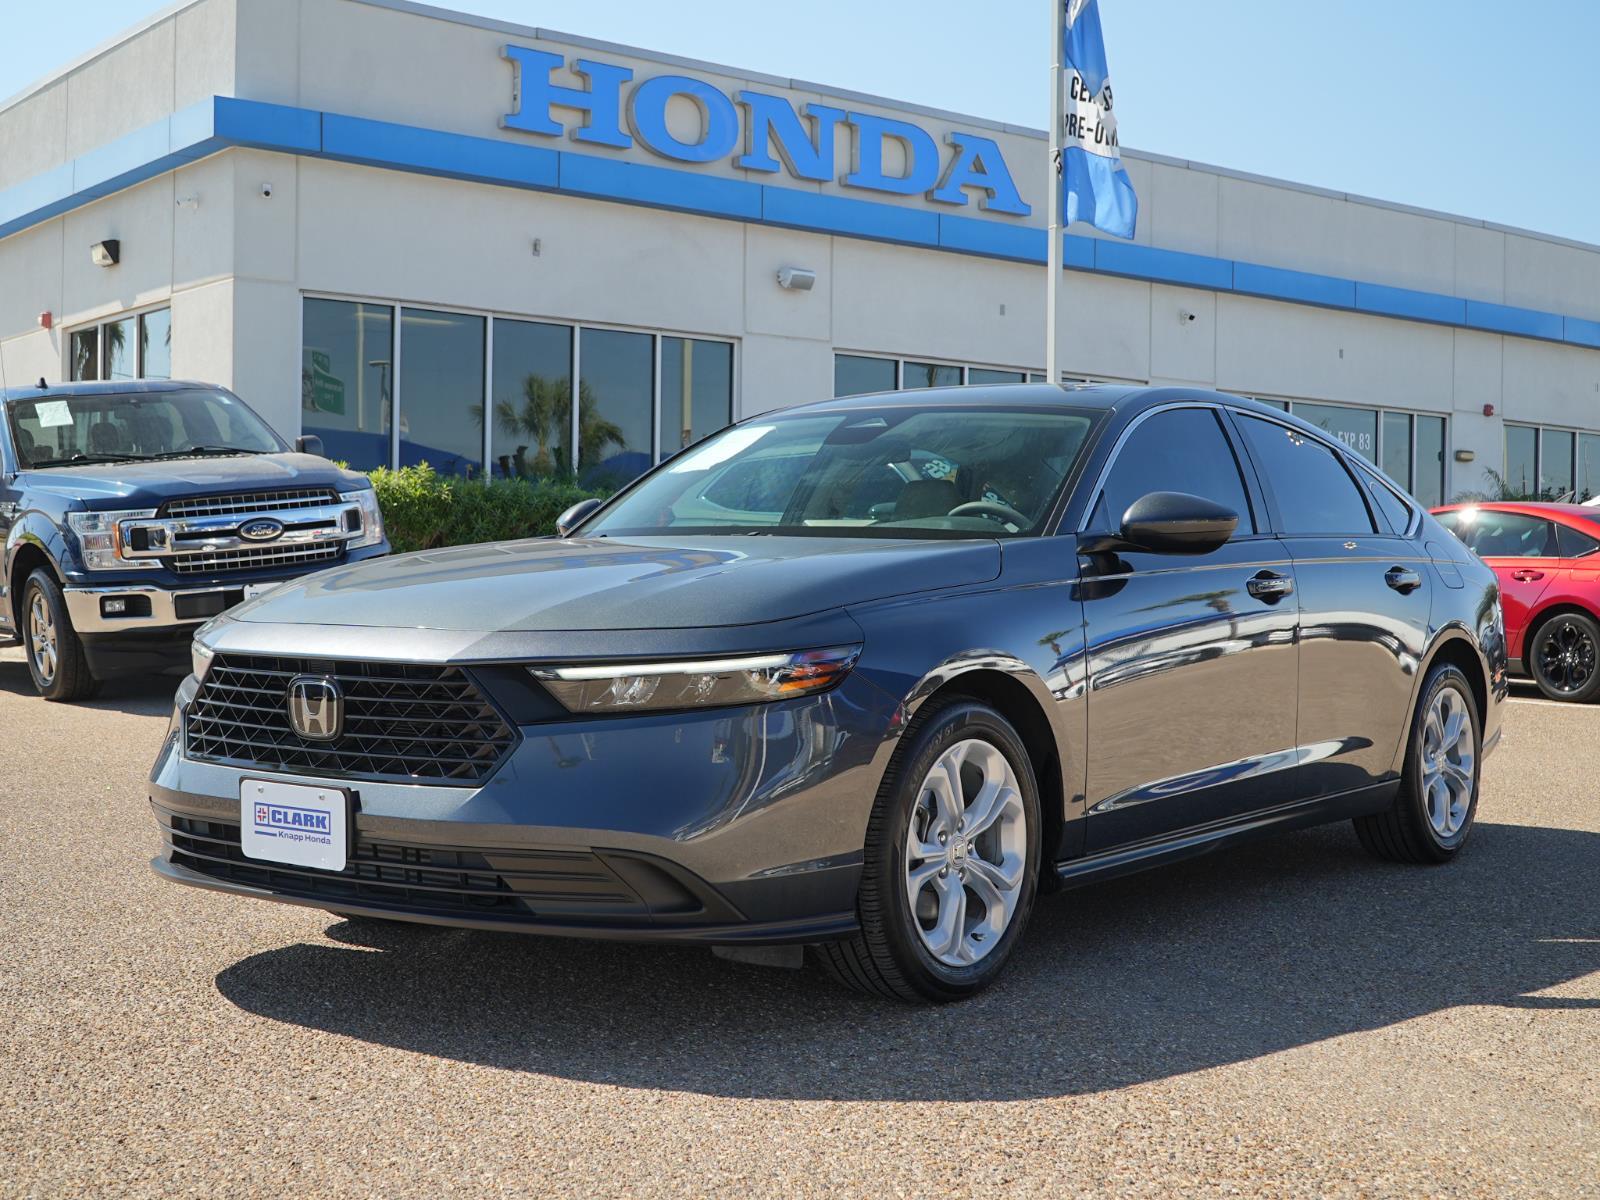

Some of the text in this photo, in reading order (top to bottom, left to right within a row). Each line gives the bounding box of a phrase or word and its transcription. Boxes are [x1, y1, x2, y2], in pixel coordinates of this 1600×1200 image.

[501, 45, 1031, 216] HONDA
[1359, 433, 1371, 450] 83
[271, 809, 327, 829] CLARK
[278, 831, 331, 844] Knapp Honda
